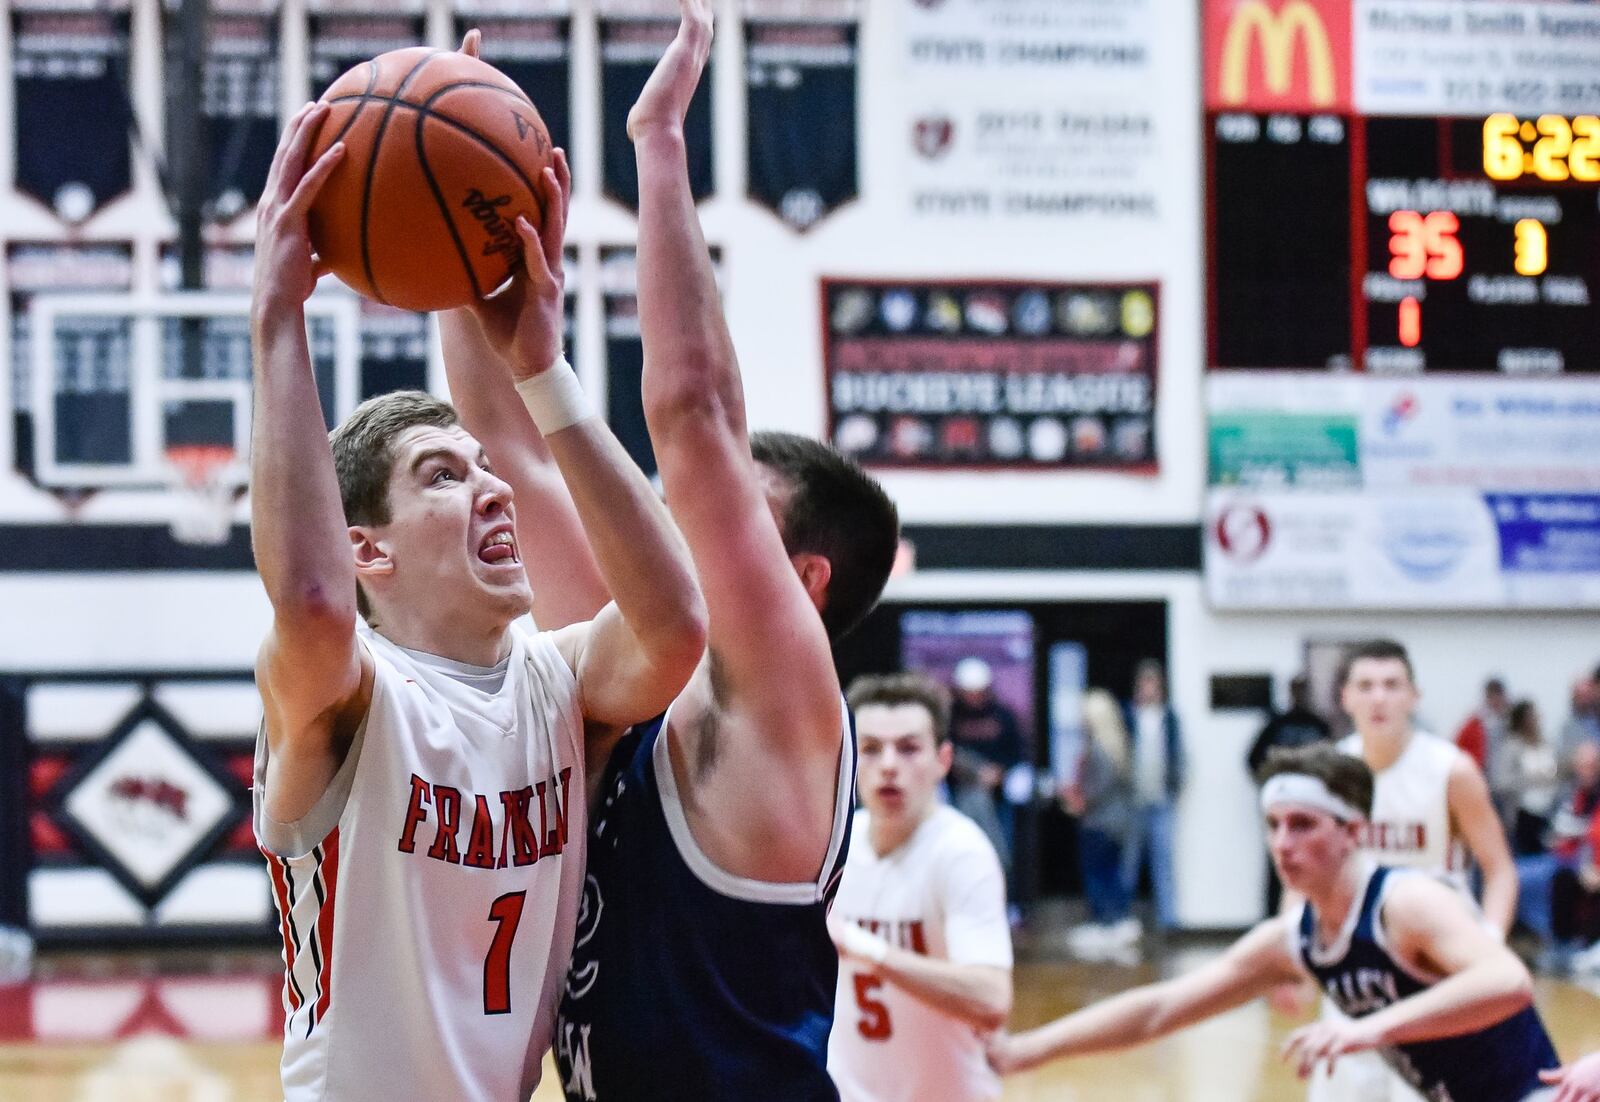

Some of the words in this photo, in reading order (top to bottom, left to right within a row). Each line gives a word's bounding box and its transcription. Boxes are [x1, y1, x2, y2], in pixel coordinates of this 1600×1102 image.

[911, 40, 985, 65] STATE
[1001, 41, 1146, 67] CHAMPIONS
[1483, 112, 1600, 181] 6:22
[913, 188, 990, 214] STATE
[1388, 209, 1464, 281] 35
[1514, 217, 1547, 277] 3
[832, 371, 998, 414] BUCKEYE
[1003, 371, 1151, 414] LEAGUE
[398, 766, 572, 870] FRANKLN
[482, 889, 527, 1015] 1
[852, 970, 893, 1042] 5
